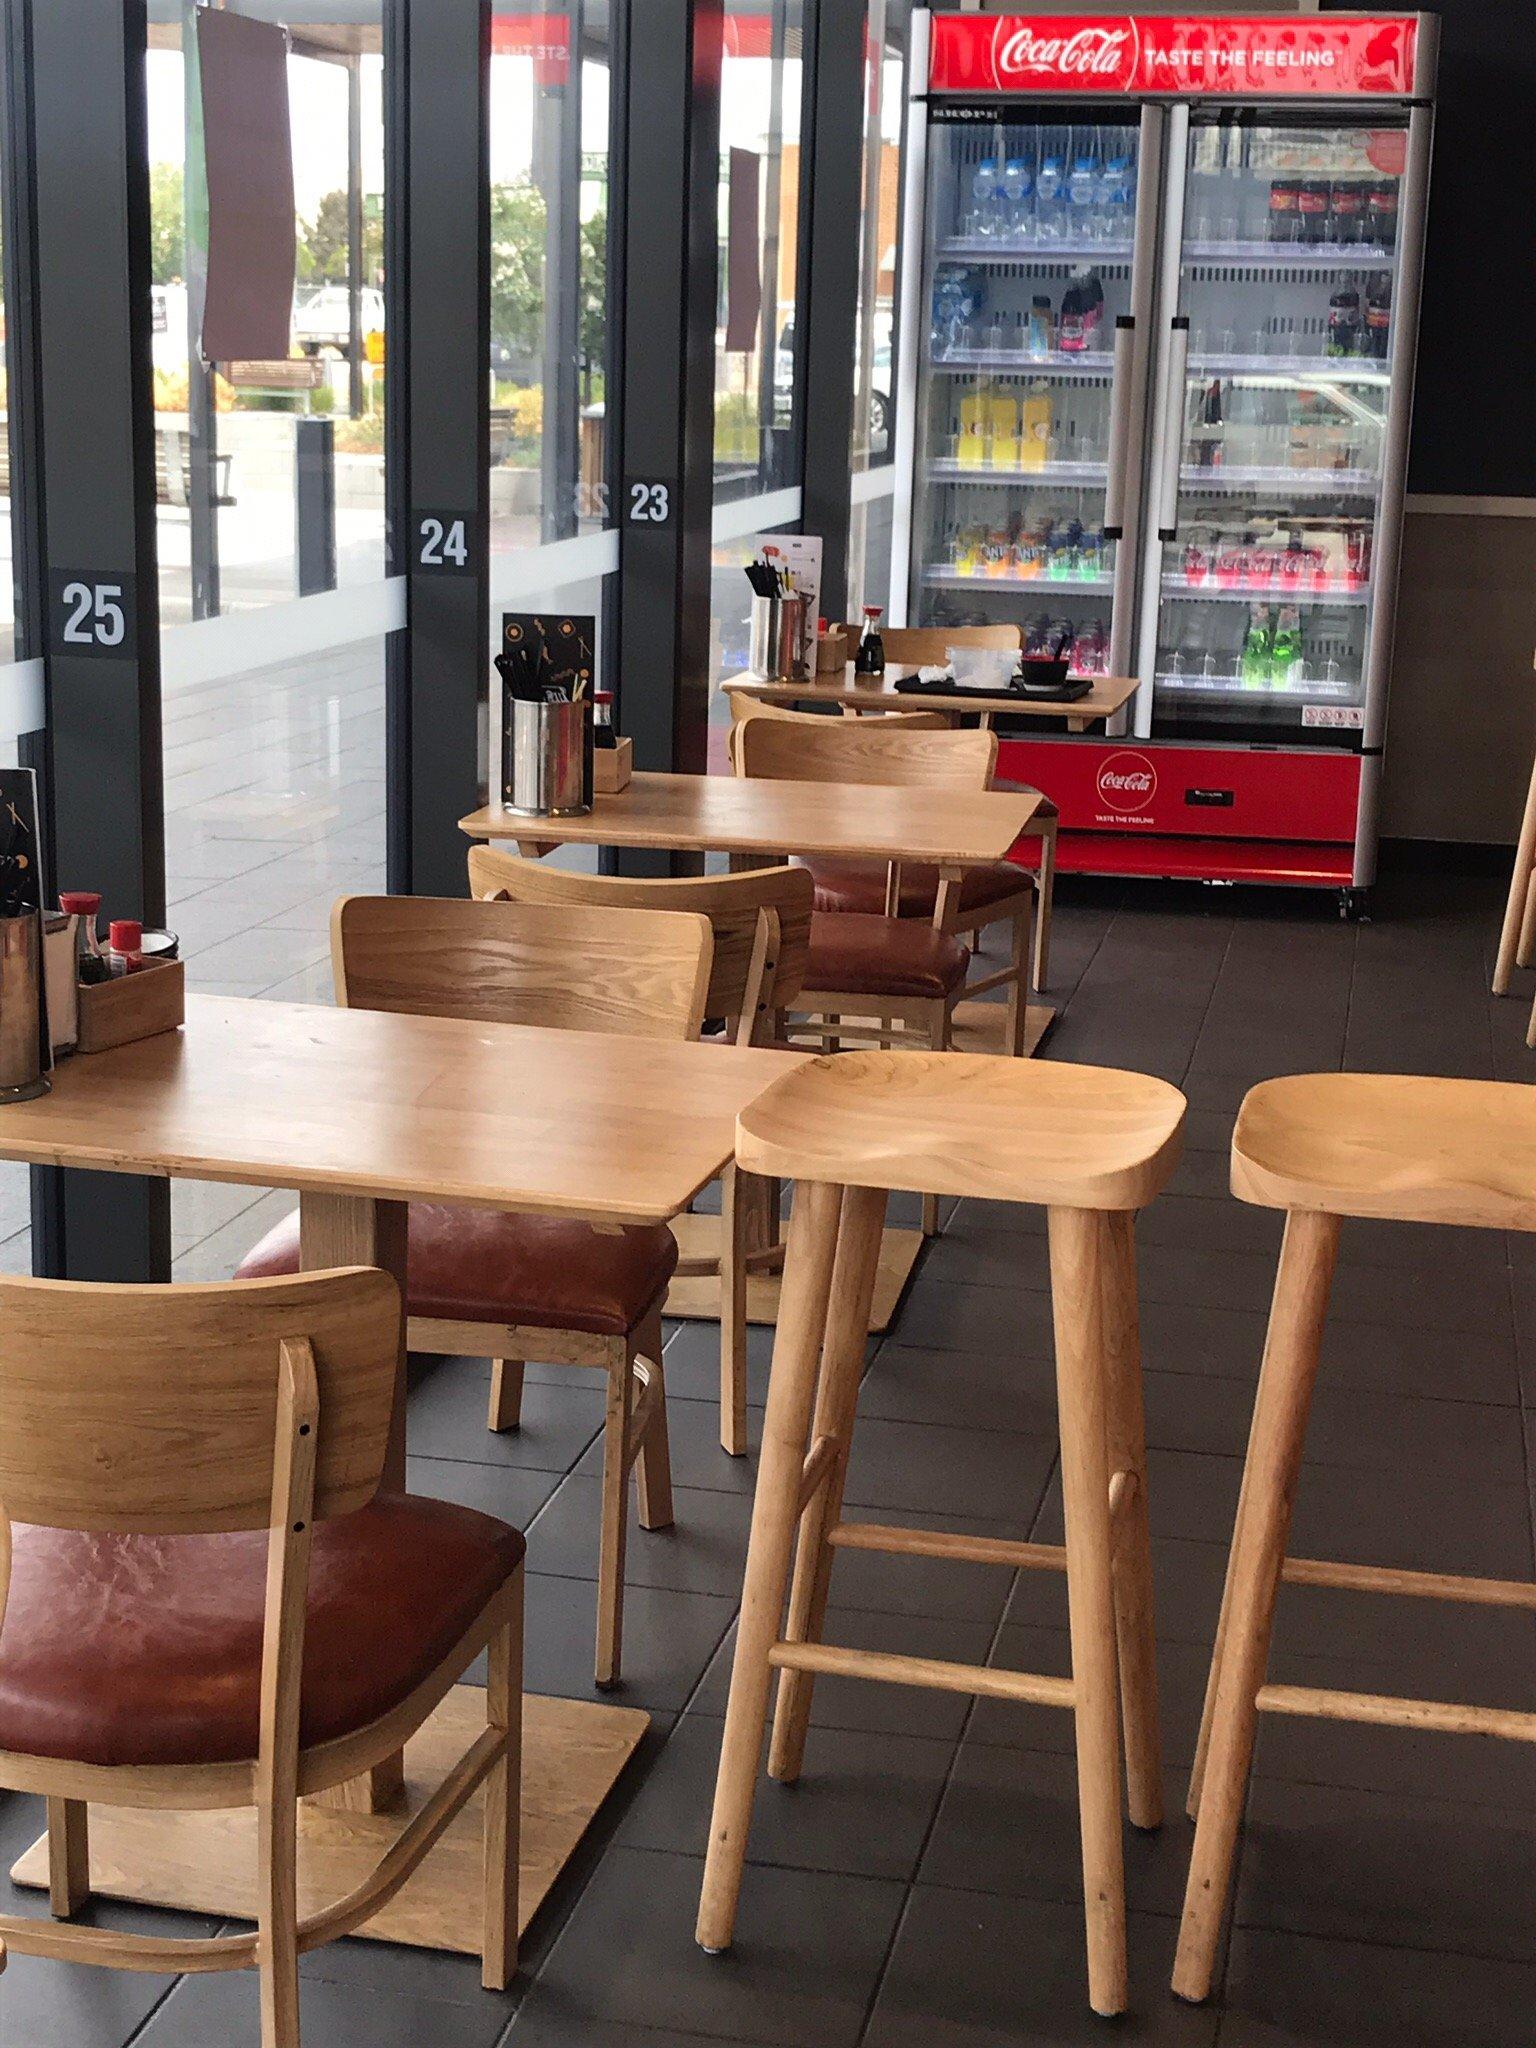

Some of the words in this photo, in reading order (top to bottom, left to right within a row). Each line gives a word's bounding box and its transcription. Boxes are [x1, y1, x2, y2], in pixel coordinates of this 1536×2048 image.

[1001, 28, 1130, 73] Coca-Cola
[1144, 50, 1203, 66] TASTE
[1209, 50, 1246, 66] THE
[1253, 50, 1335, 67] FEELING
[630, 483, 669, 522] 23
[420, 518, 468, 567] 24
[63, 582, 125, 646] 25
[1100, 771, 1153, 791] Coca-Cola
